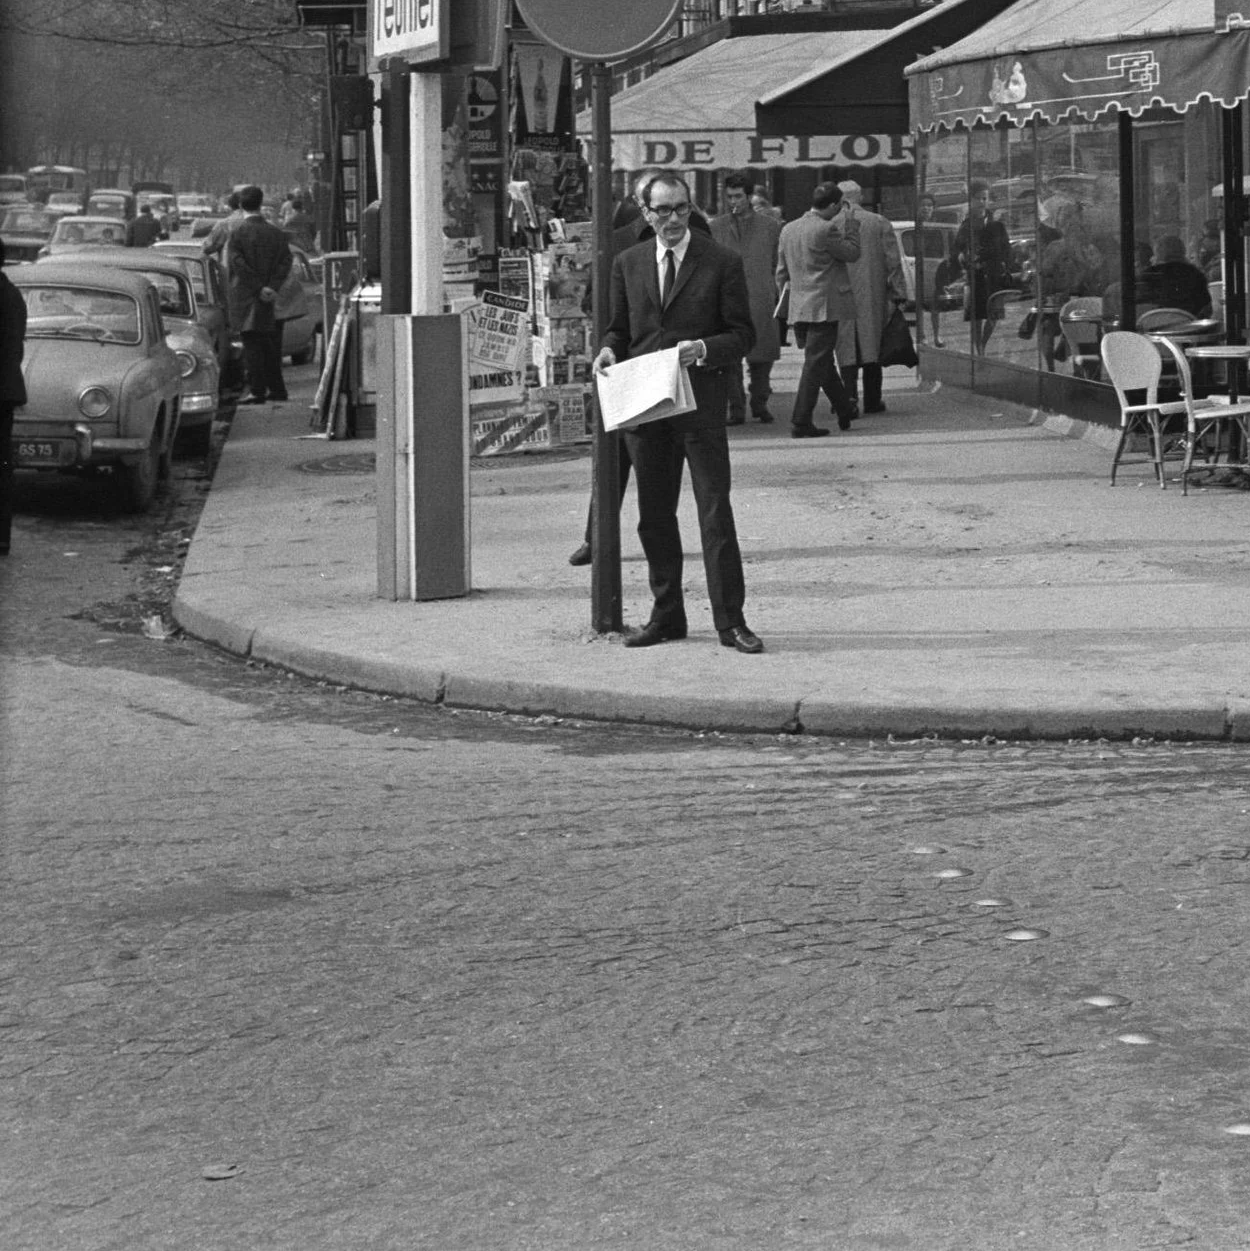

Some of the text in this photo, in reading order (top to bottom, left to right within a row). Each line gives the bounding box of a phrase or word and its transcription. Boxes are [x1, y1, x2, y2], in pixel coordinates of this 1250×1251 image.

[643, 140, 714, 165] DE
[747, 135, 916, 164] FLOR
[486, 295, 527, 311] CANDIDE
[38, 443, 53, 456] 75
